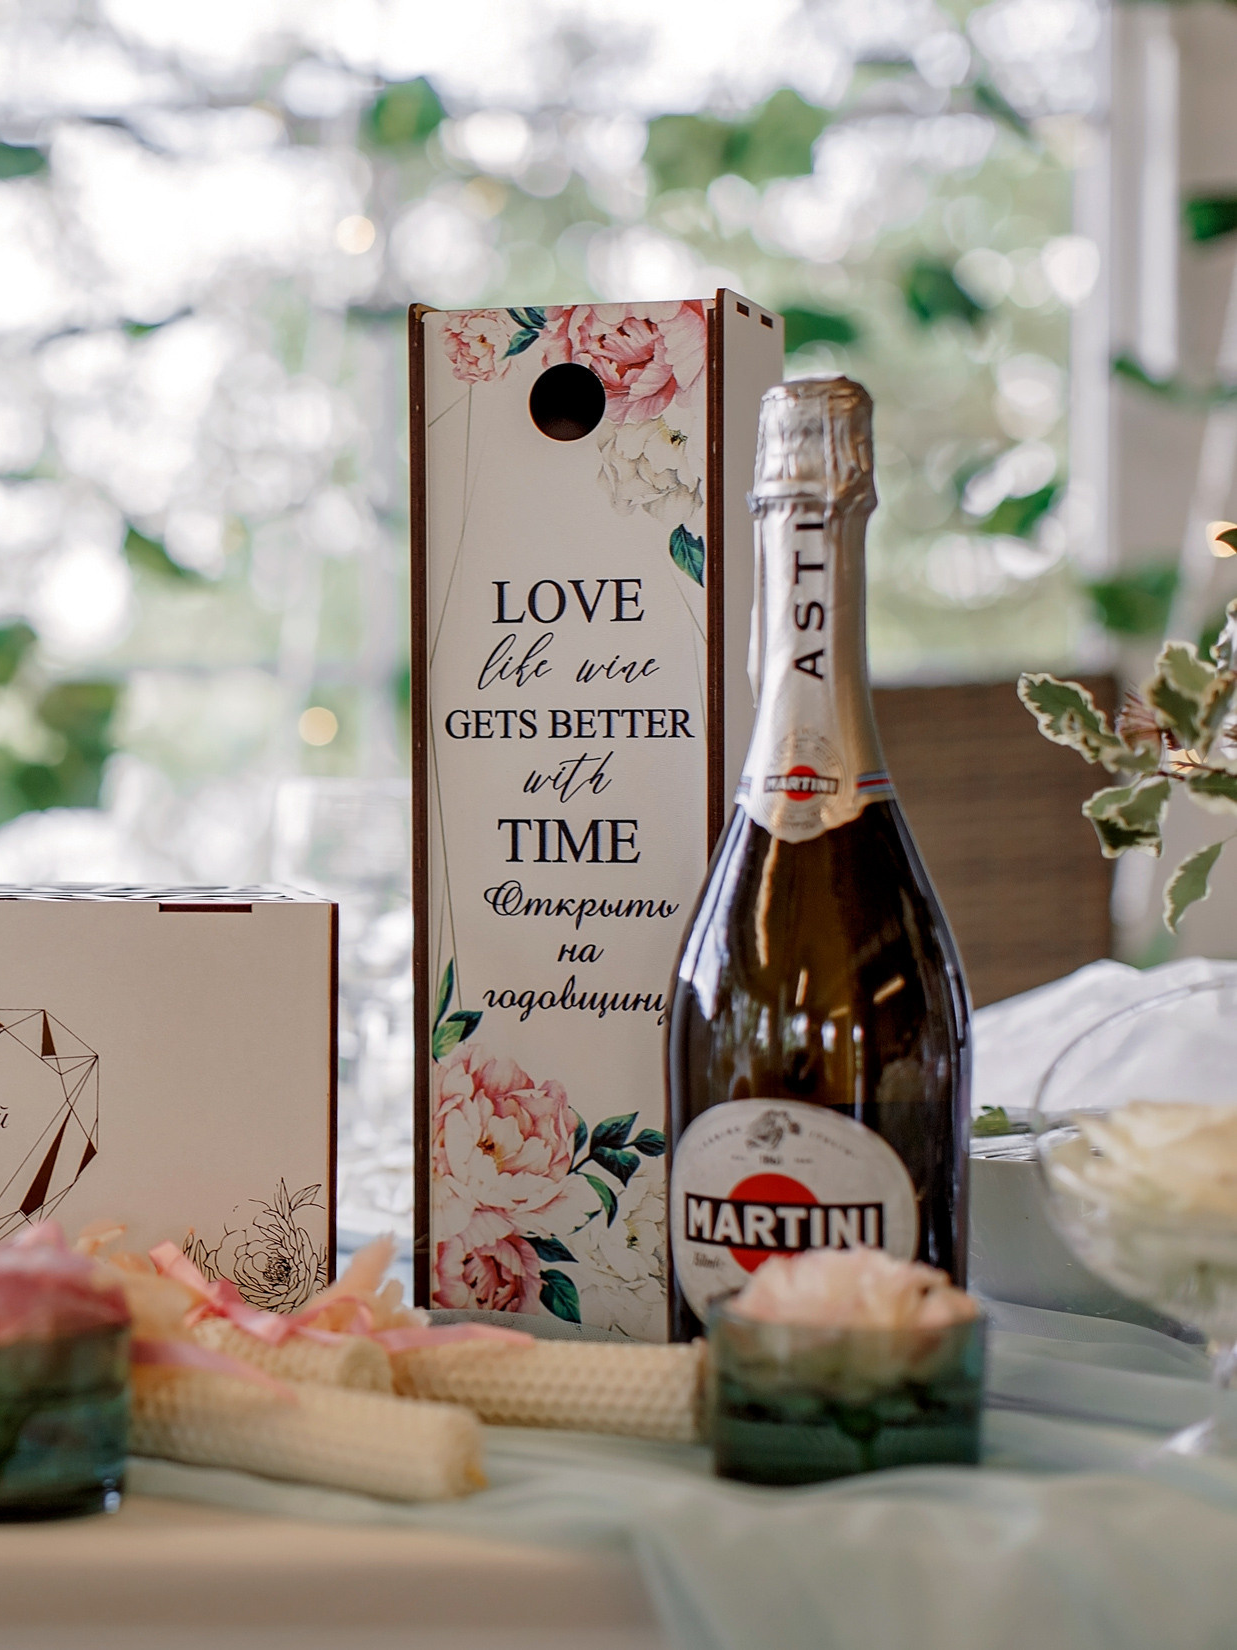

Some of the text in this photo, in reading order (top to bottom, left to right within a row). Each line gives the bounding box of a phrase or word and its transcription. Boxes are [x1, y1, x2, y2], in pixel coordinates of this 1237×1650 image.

[491, 578, 645, 624] LOVE
[794, 521, 825, 681] ASTI
[477, 631, 660, 690] like wine
[445, 708, 695, 739] GETS BETTER
[523, 751, 614, 803] with
[766, 776, 837, 794] MARTINI
[497, 818, 641, 863] TIME
[483, 880, 679, 930] Открыть
[557, 943, 604, 963] на
[687, 1197, 880, 1249] MARTINI
